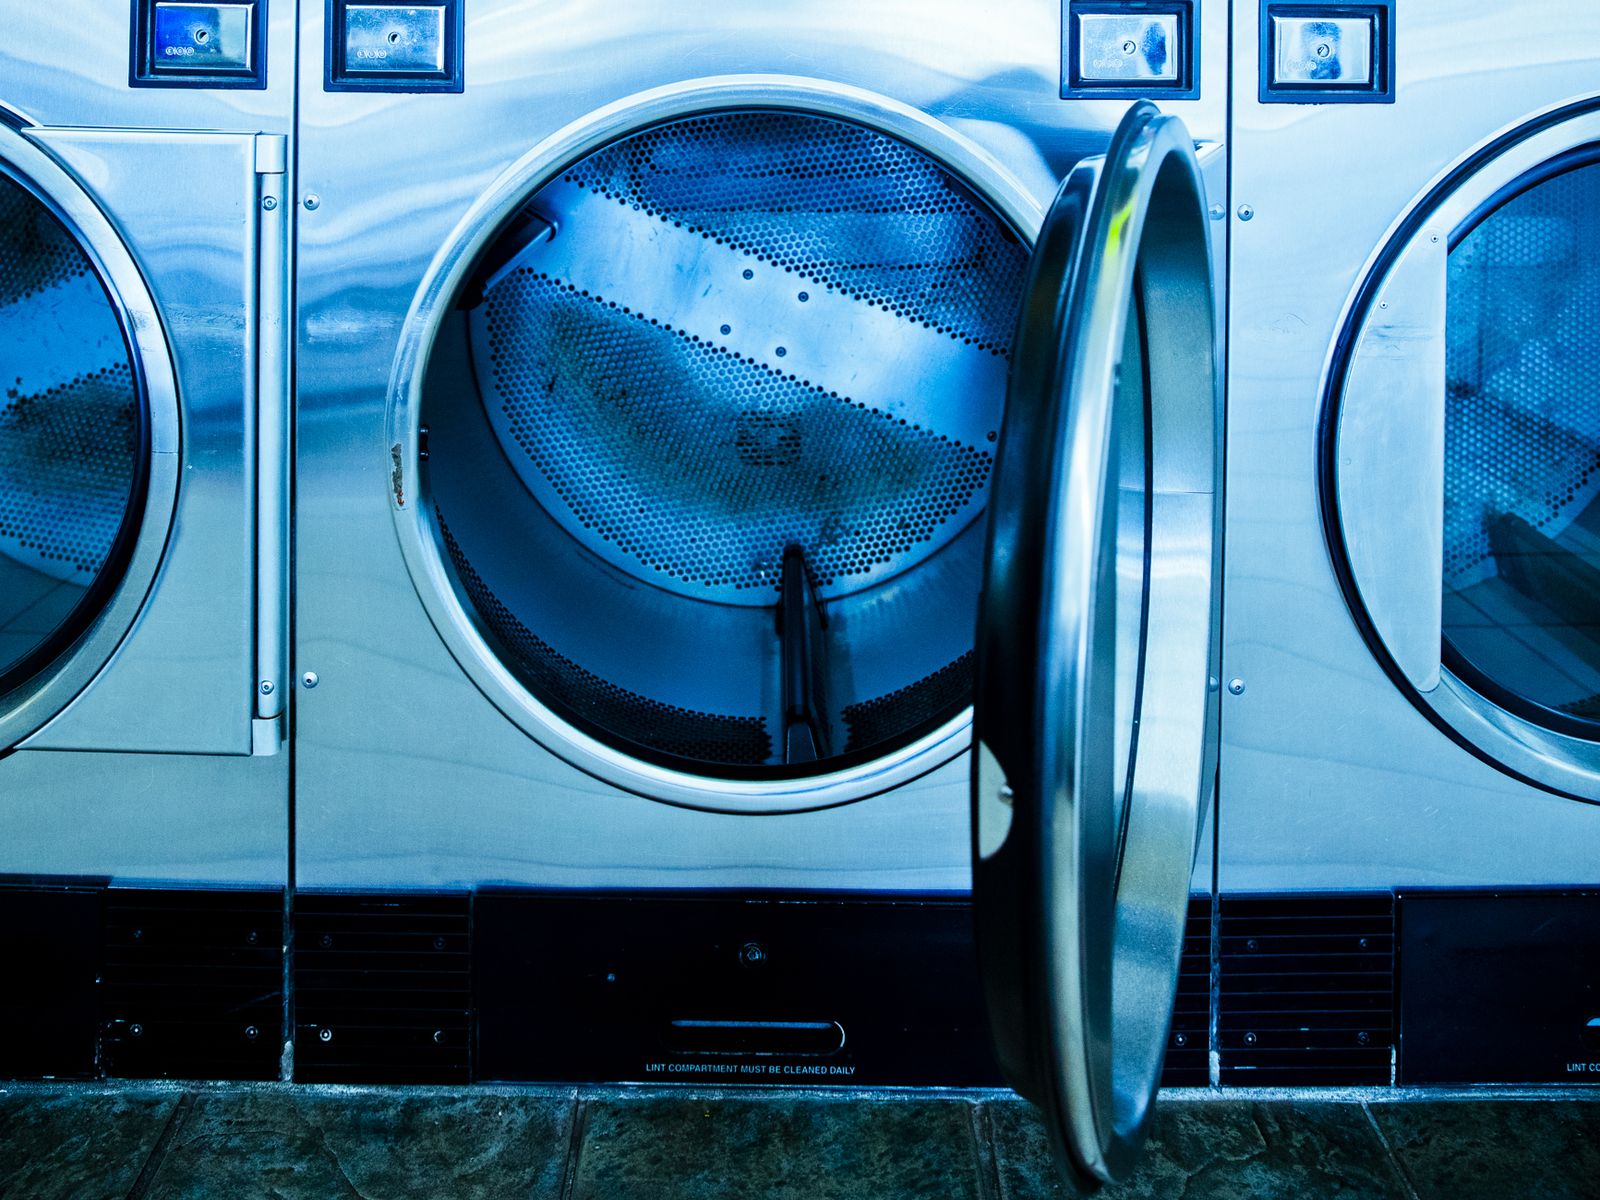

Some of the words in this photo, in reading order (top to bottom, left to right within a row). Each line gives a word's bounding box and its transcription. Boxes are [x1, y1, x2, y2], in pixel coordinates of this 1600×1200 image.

[646, 1064, 666, 1072] LINT
[668, 1064, 738, 1073] COMPARTMENT
[741, 1065, 766, 1074] MUST
[769, 1065, 781, 1074] BE
[784, 1066, 827, 1075] CLEANED
[830, 1066, 856, 1075] DAILY
[1567, 1064, 1587, 1072] LINT
